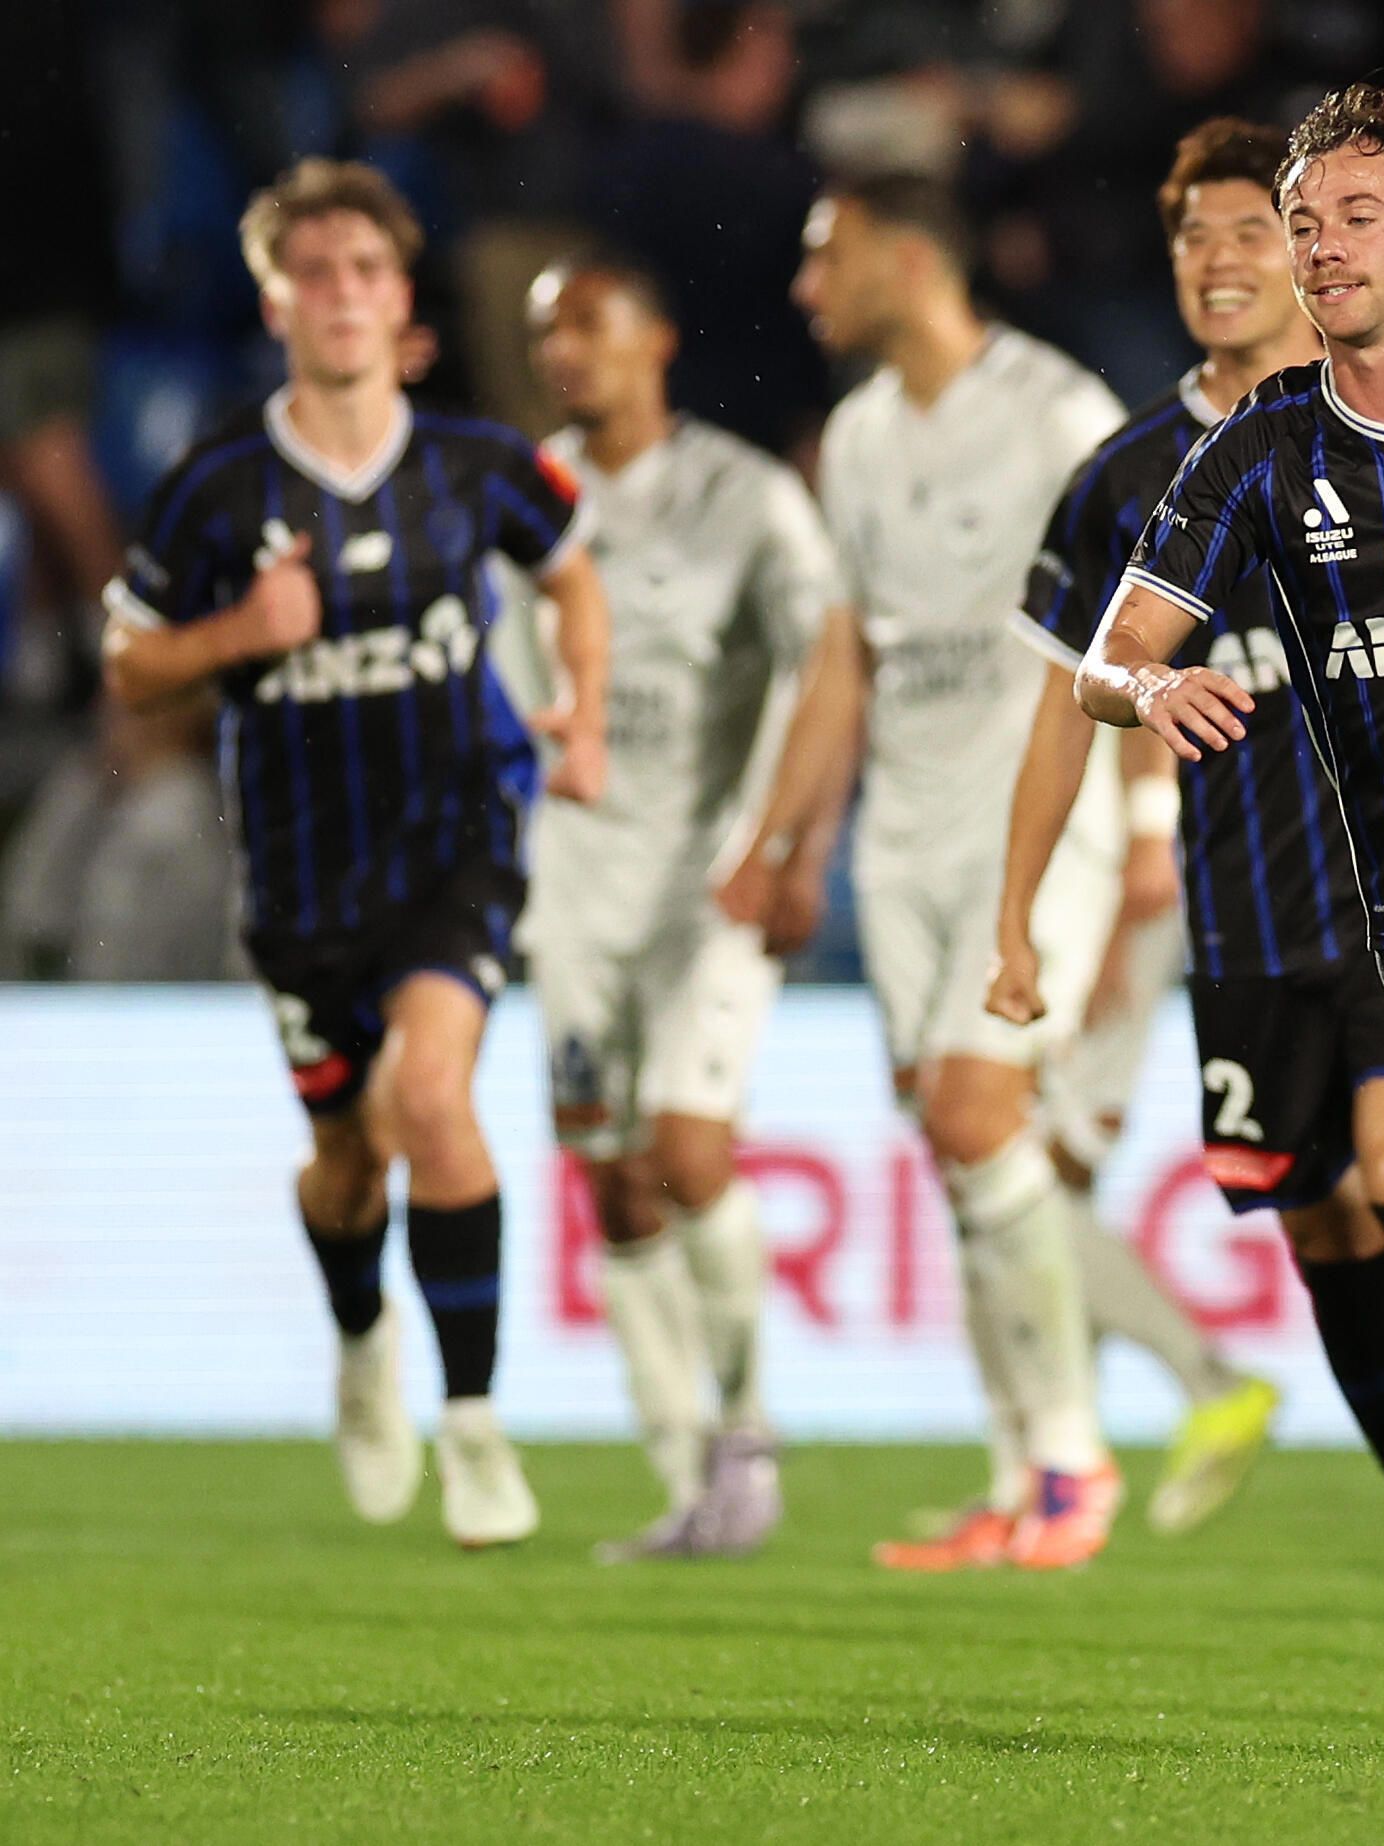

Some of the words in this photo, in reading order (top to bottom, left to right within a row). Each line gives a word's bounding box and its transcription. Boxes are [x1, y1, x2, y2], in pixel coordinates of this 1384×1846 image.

[1305, 527, 1354, 544] ISUZU
[1315, 540, 1345, 551] UTE
[1207, 626, 1293, 693] AN
